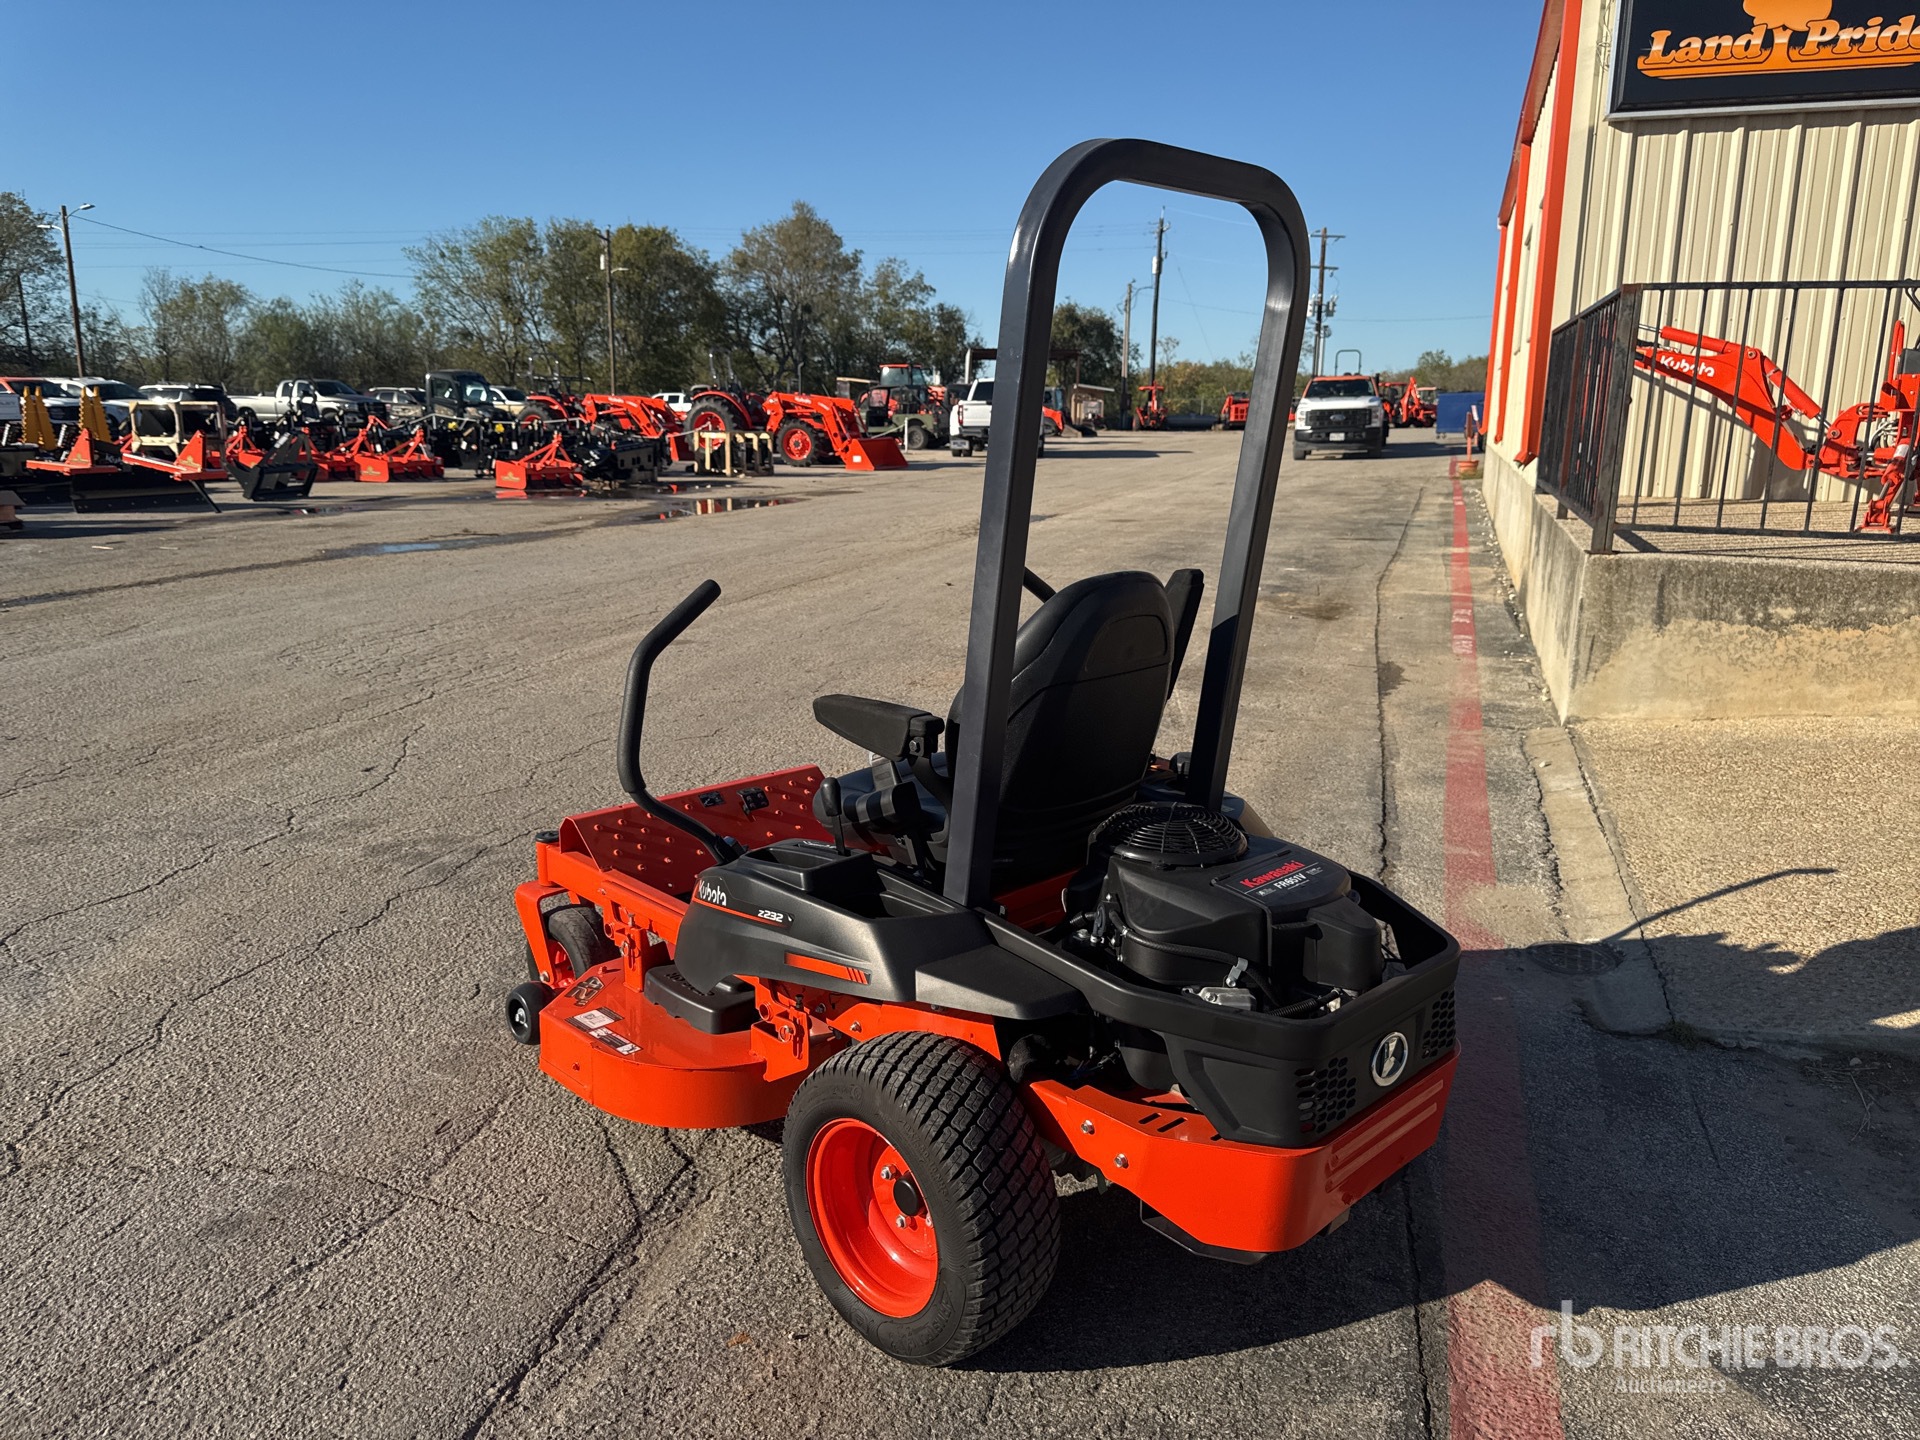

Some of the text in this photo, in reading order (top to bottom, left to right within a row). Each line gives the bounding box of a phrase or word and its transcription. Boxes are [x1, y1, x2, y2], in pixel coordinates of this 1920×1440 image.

[1644, 23, 1768, 65] Land
[1240, 860, 1306, 888] Kawasaki
[698, 880, 727, 906] Kubota
[757, 909, 784, 923] Z232
